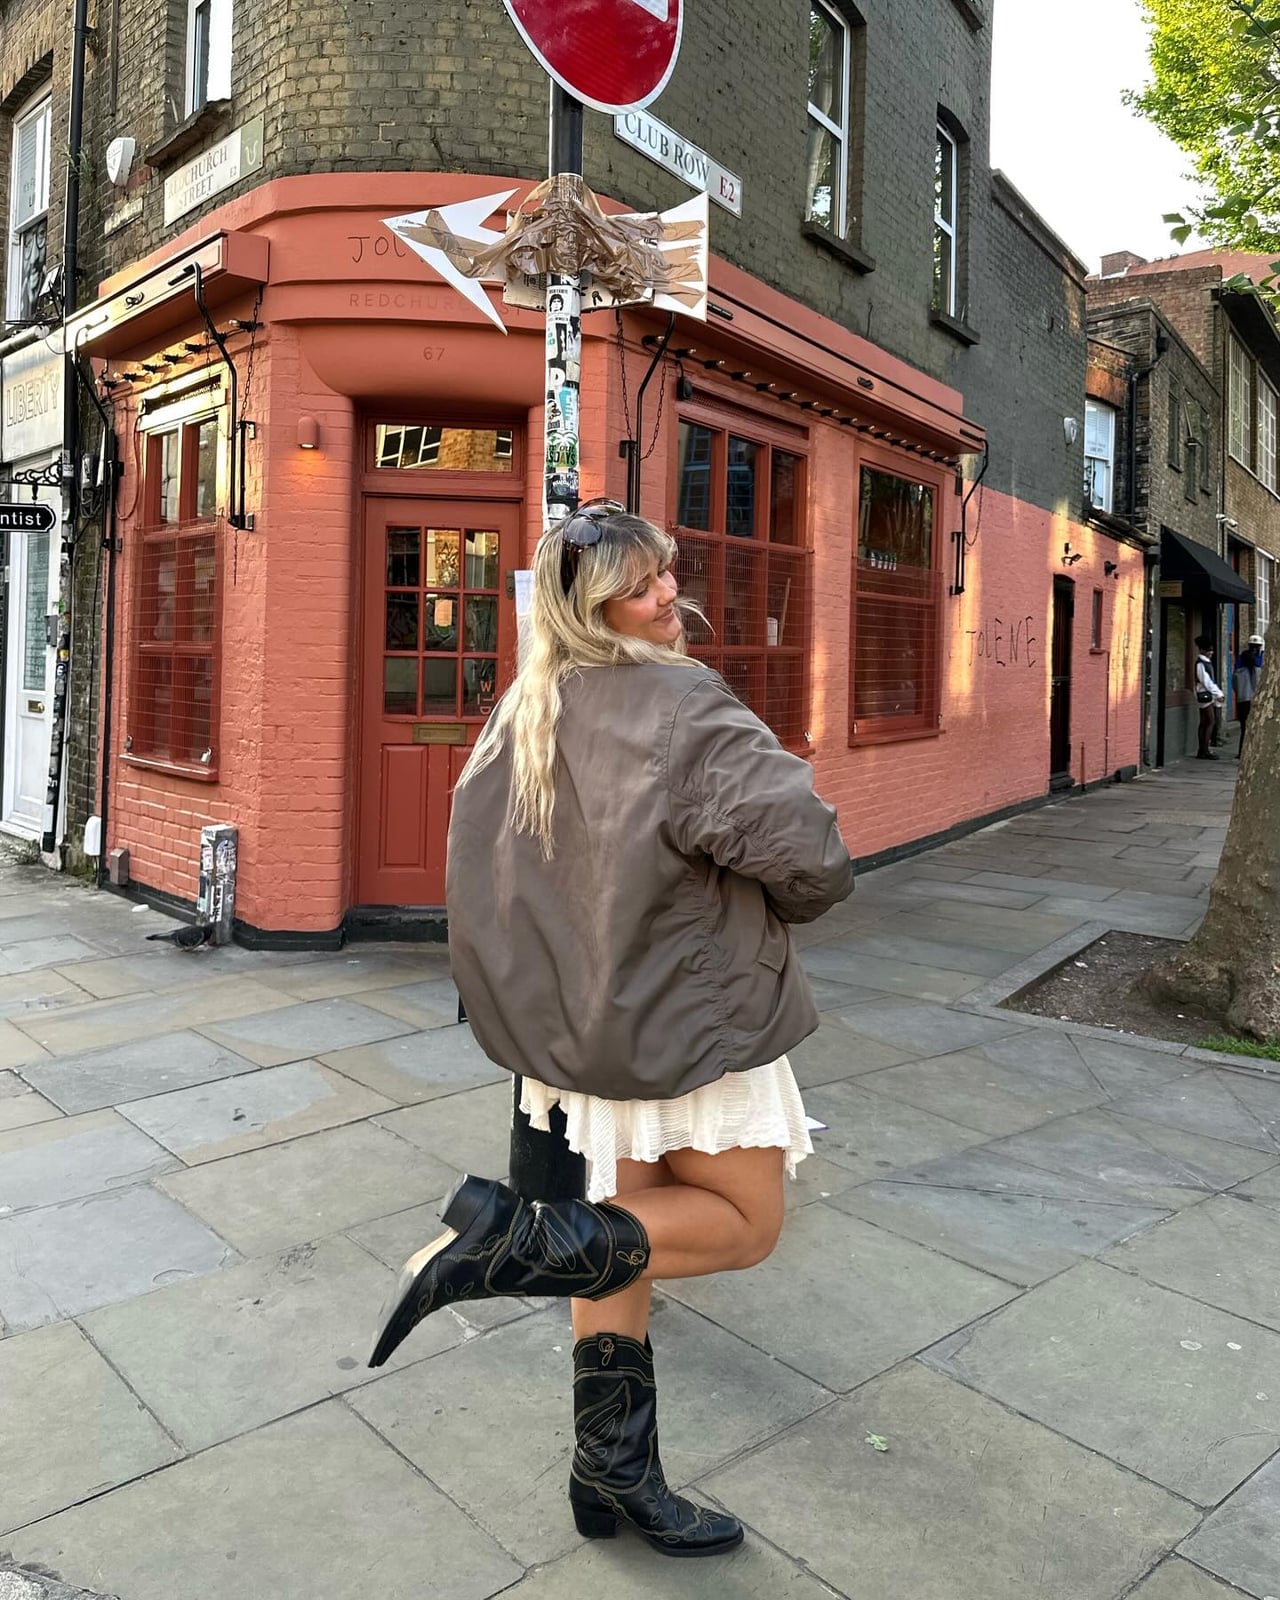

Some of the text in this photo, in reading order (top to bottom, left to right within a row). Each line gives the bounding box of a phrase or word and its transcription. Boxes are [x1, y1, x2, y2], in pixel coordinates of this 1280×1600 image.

[168, 145, 227, 199] REDCHURCH
[624, 112, 735, 203] CLUB ROW E2
[179, 174, 213, 209] STREET
[348, 235, 406, 263] JOL
[350, 293, 472, 312] REDCHURC
[422, 346, 445, 361] 67
[7, 373, 60, 427] LIBERTY
[0, 511, 42, 526] ntist
